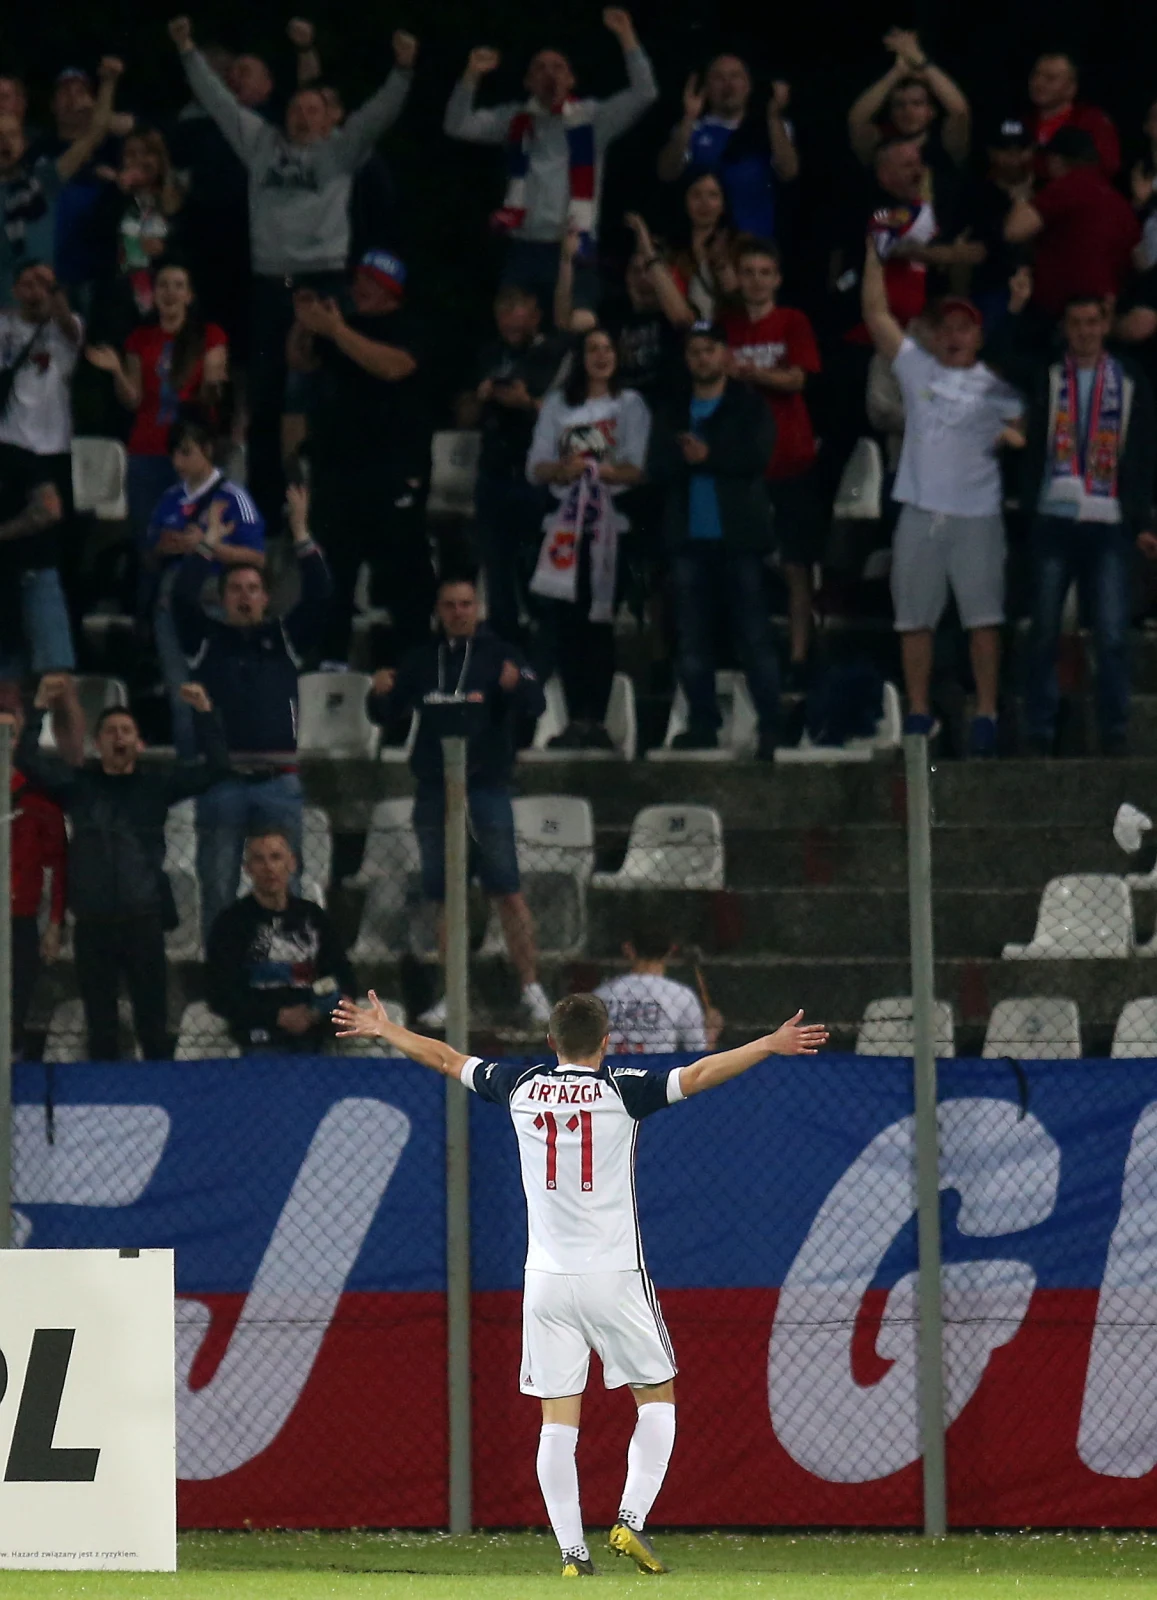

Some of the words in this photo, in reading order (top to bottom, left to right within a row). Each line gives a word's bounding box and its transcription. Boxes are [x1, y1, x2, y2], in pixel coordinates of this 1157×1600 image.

[533, 1109, 593, 1192] 11
[0, 1329, 101, 1482] L
[11, 1550, 39, 1558] Hazard
[41, 1551, 77, 1560] związany
[78, 1551, 93, 1560] jest
[101, 1550, 139, 1560] ryzykiem.
